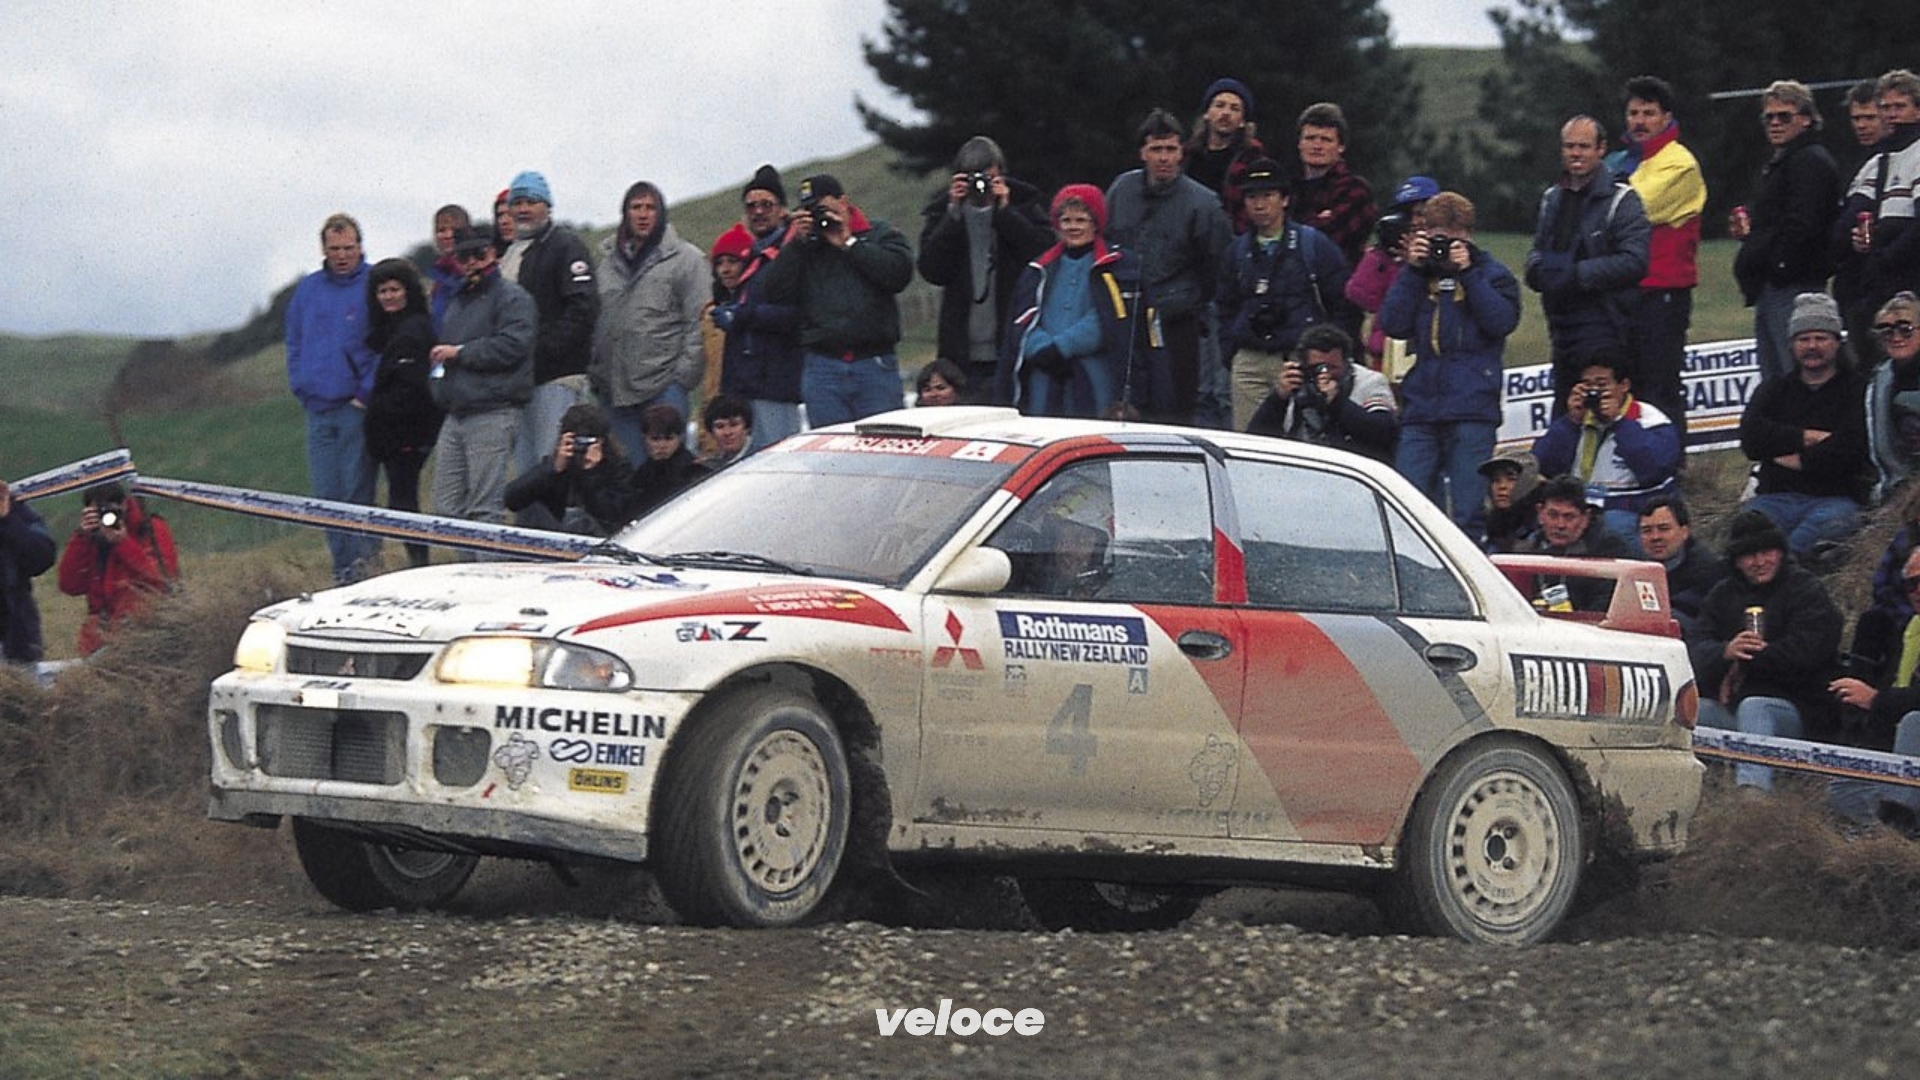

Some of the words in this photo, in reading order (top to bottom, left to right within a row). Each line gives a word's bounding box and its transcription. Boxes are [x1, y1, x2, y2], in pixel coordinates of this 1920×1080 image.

[723, 621, 767, 641] Z
[1015, 613, 1129, 643] Rothmans
[1004, 639, 1048, 660] RALLY
[1049, 642, 1081, 662] NEW
[1083, 644, 1148, 666] ZEALAND
[1522, 658, 1589, 717] RALLI
[1621, 665, 1662, 724] ART
[494, 705, 667, 739] MICHELIN
[1046, 683, 1098, 776] 4
[596, 742, 646, 767] ENKEI
